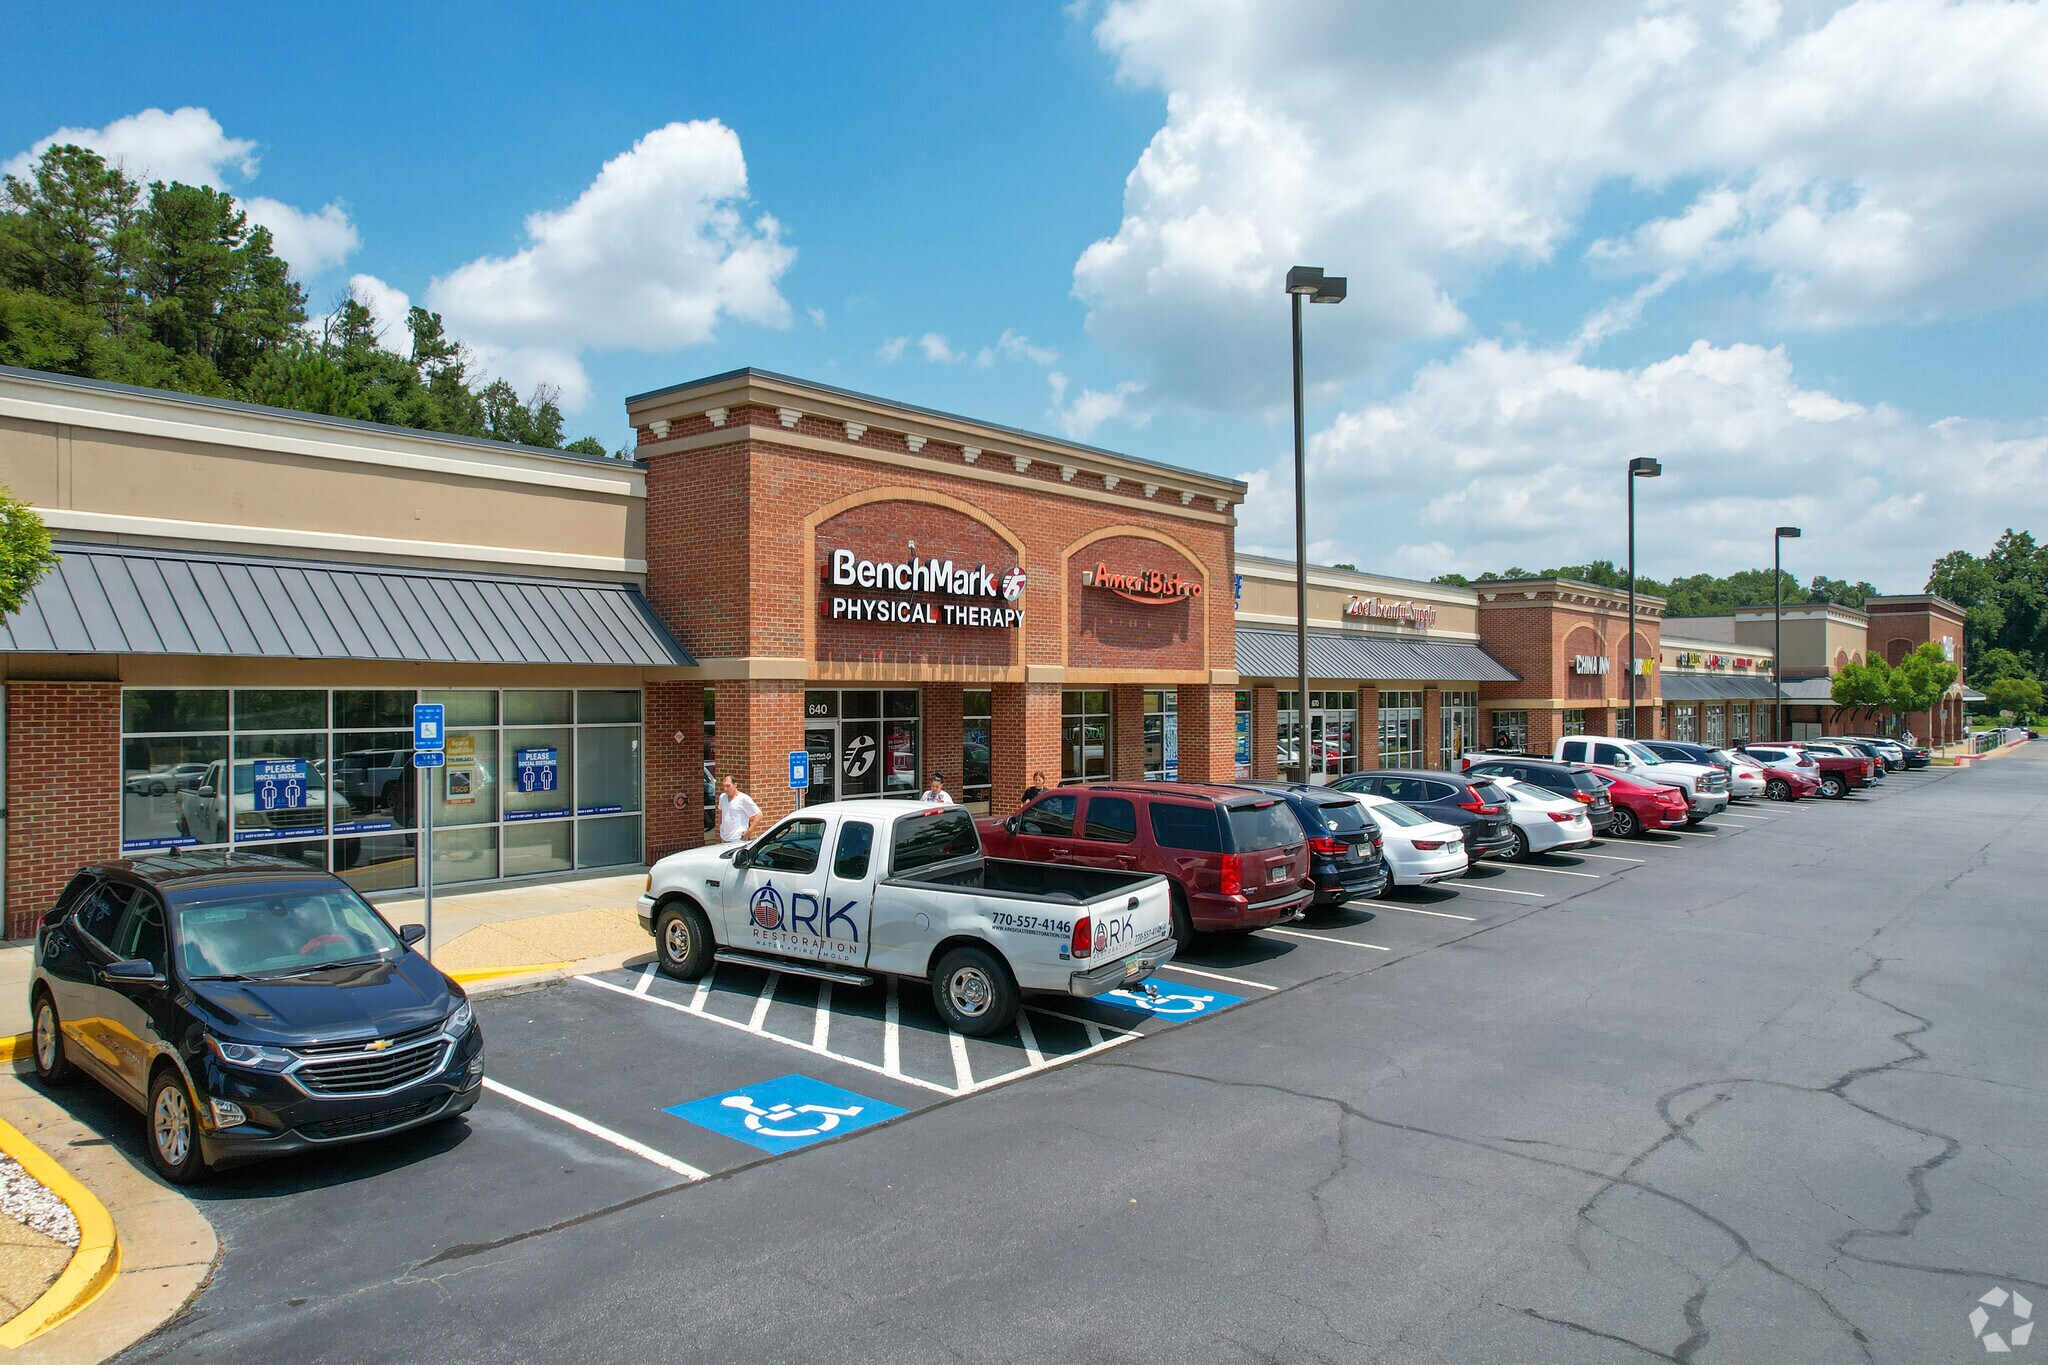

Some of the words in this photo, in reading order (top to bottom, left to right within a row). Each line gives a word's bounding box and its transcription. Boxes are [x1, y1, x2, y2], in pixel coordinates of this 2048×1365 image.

[833, 548, 997, 597] BenchMark
[1094, 561, 1201, 597] AmeriBistro
[833, 597, 937, 624] PHYSICAL
[943, 604, 1025, 628] THERAPY
[1348, 595, 1372, 616] Zoet
[1375, 597, 1406, 625] Beauty
[1409, 601, 1436, 629] Supply
[1575, 655, 1597, 675] CHINA
[1598, 656, 1610, 675] INN
[1634, 657, 1655, 676] UBWAY
[808, 704, 828, 715] 640
[525, 752, 550, 760] PLEASE
[265, 764, 297, 774] PLEASE
[277, 772, 306, 780] DISTANCE
[749, 879, 859, 943] ARK
[991, 925, 1071, 940] WWW.ARKDISASTERRESTORATION.COM
[992, 911, 1071, 934] 770-557-4146
[1093, 912, 1134, 954] ARK
[752, 928, 858, 955] RESTORATION
[755, 940, 785, 950] WATER
[793, 946, 815, 956] FIRE
[823, 952, 850, 961] MOLD
